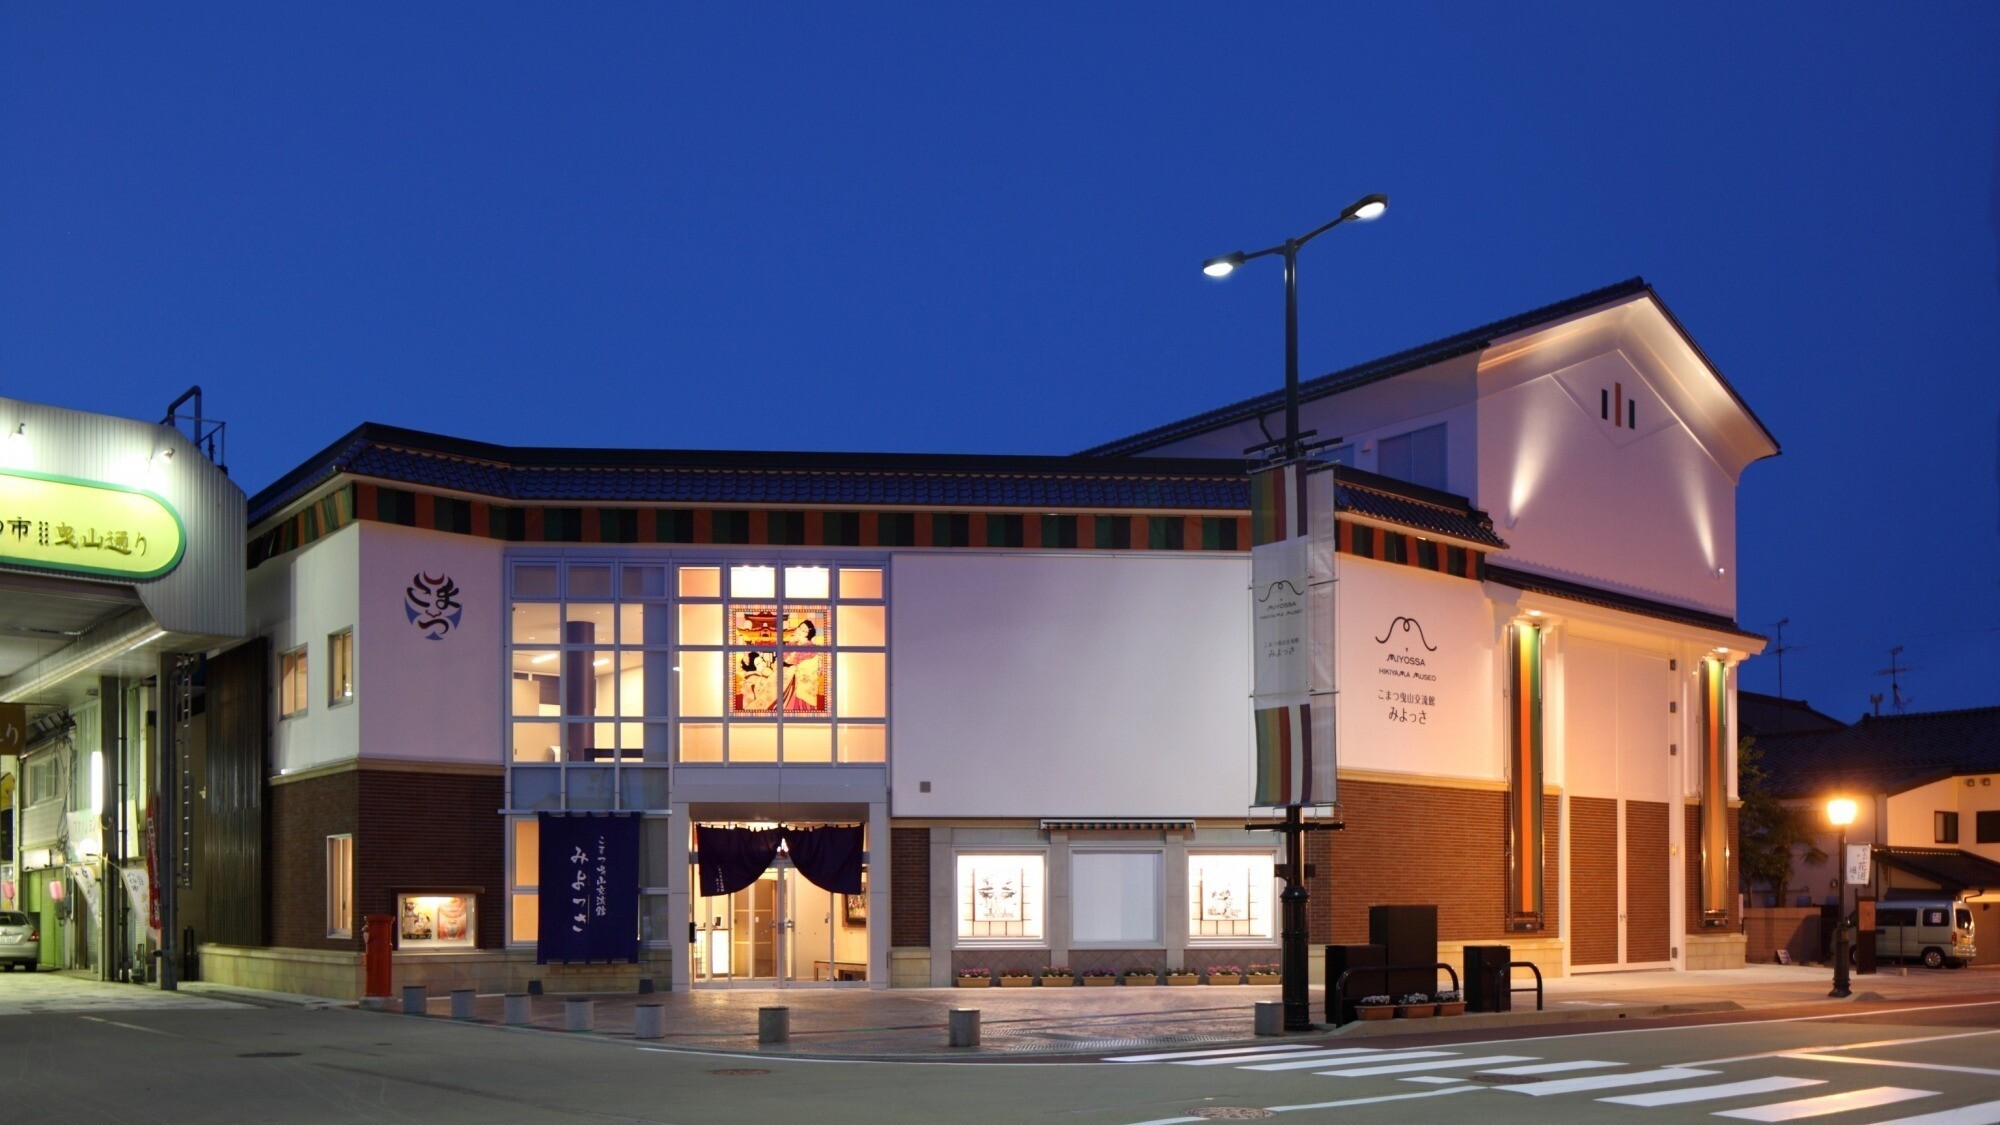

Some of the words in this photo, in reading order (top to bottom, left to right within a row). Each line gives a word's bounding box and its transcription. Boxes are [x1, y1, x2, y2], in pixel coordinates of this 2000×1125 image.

[54, 521, 148, 557] 曳山通り
[1386, 653, 1426, 667] MIYOSSA
[1378, 667, 1411, 678] HIKIYAMA
[1412, 672, 1437, 682] MUSEO
[1378, 689, 1436, 707] こまつ曳山交流館
[1388, 706, 1427, 725] みよっさ
[570, 845, 589, 933] みよっさ
